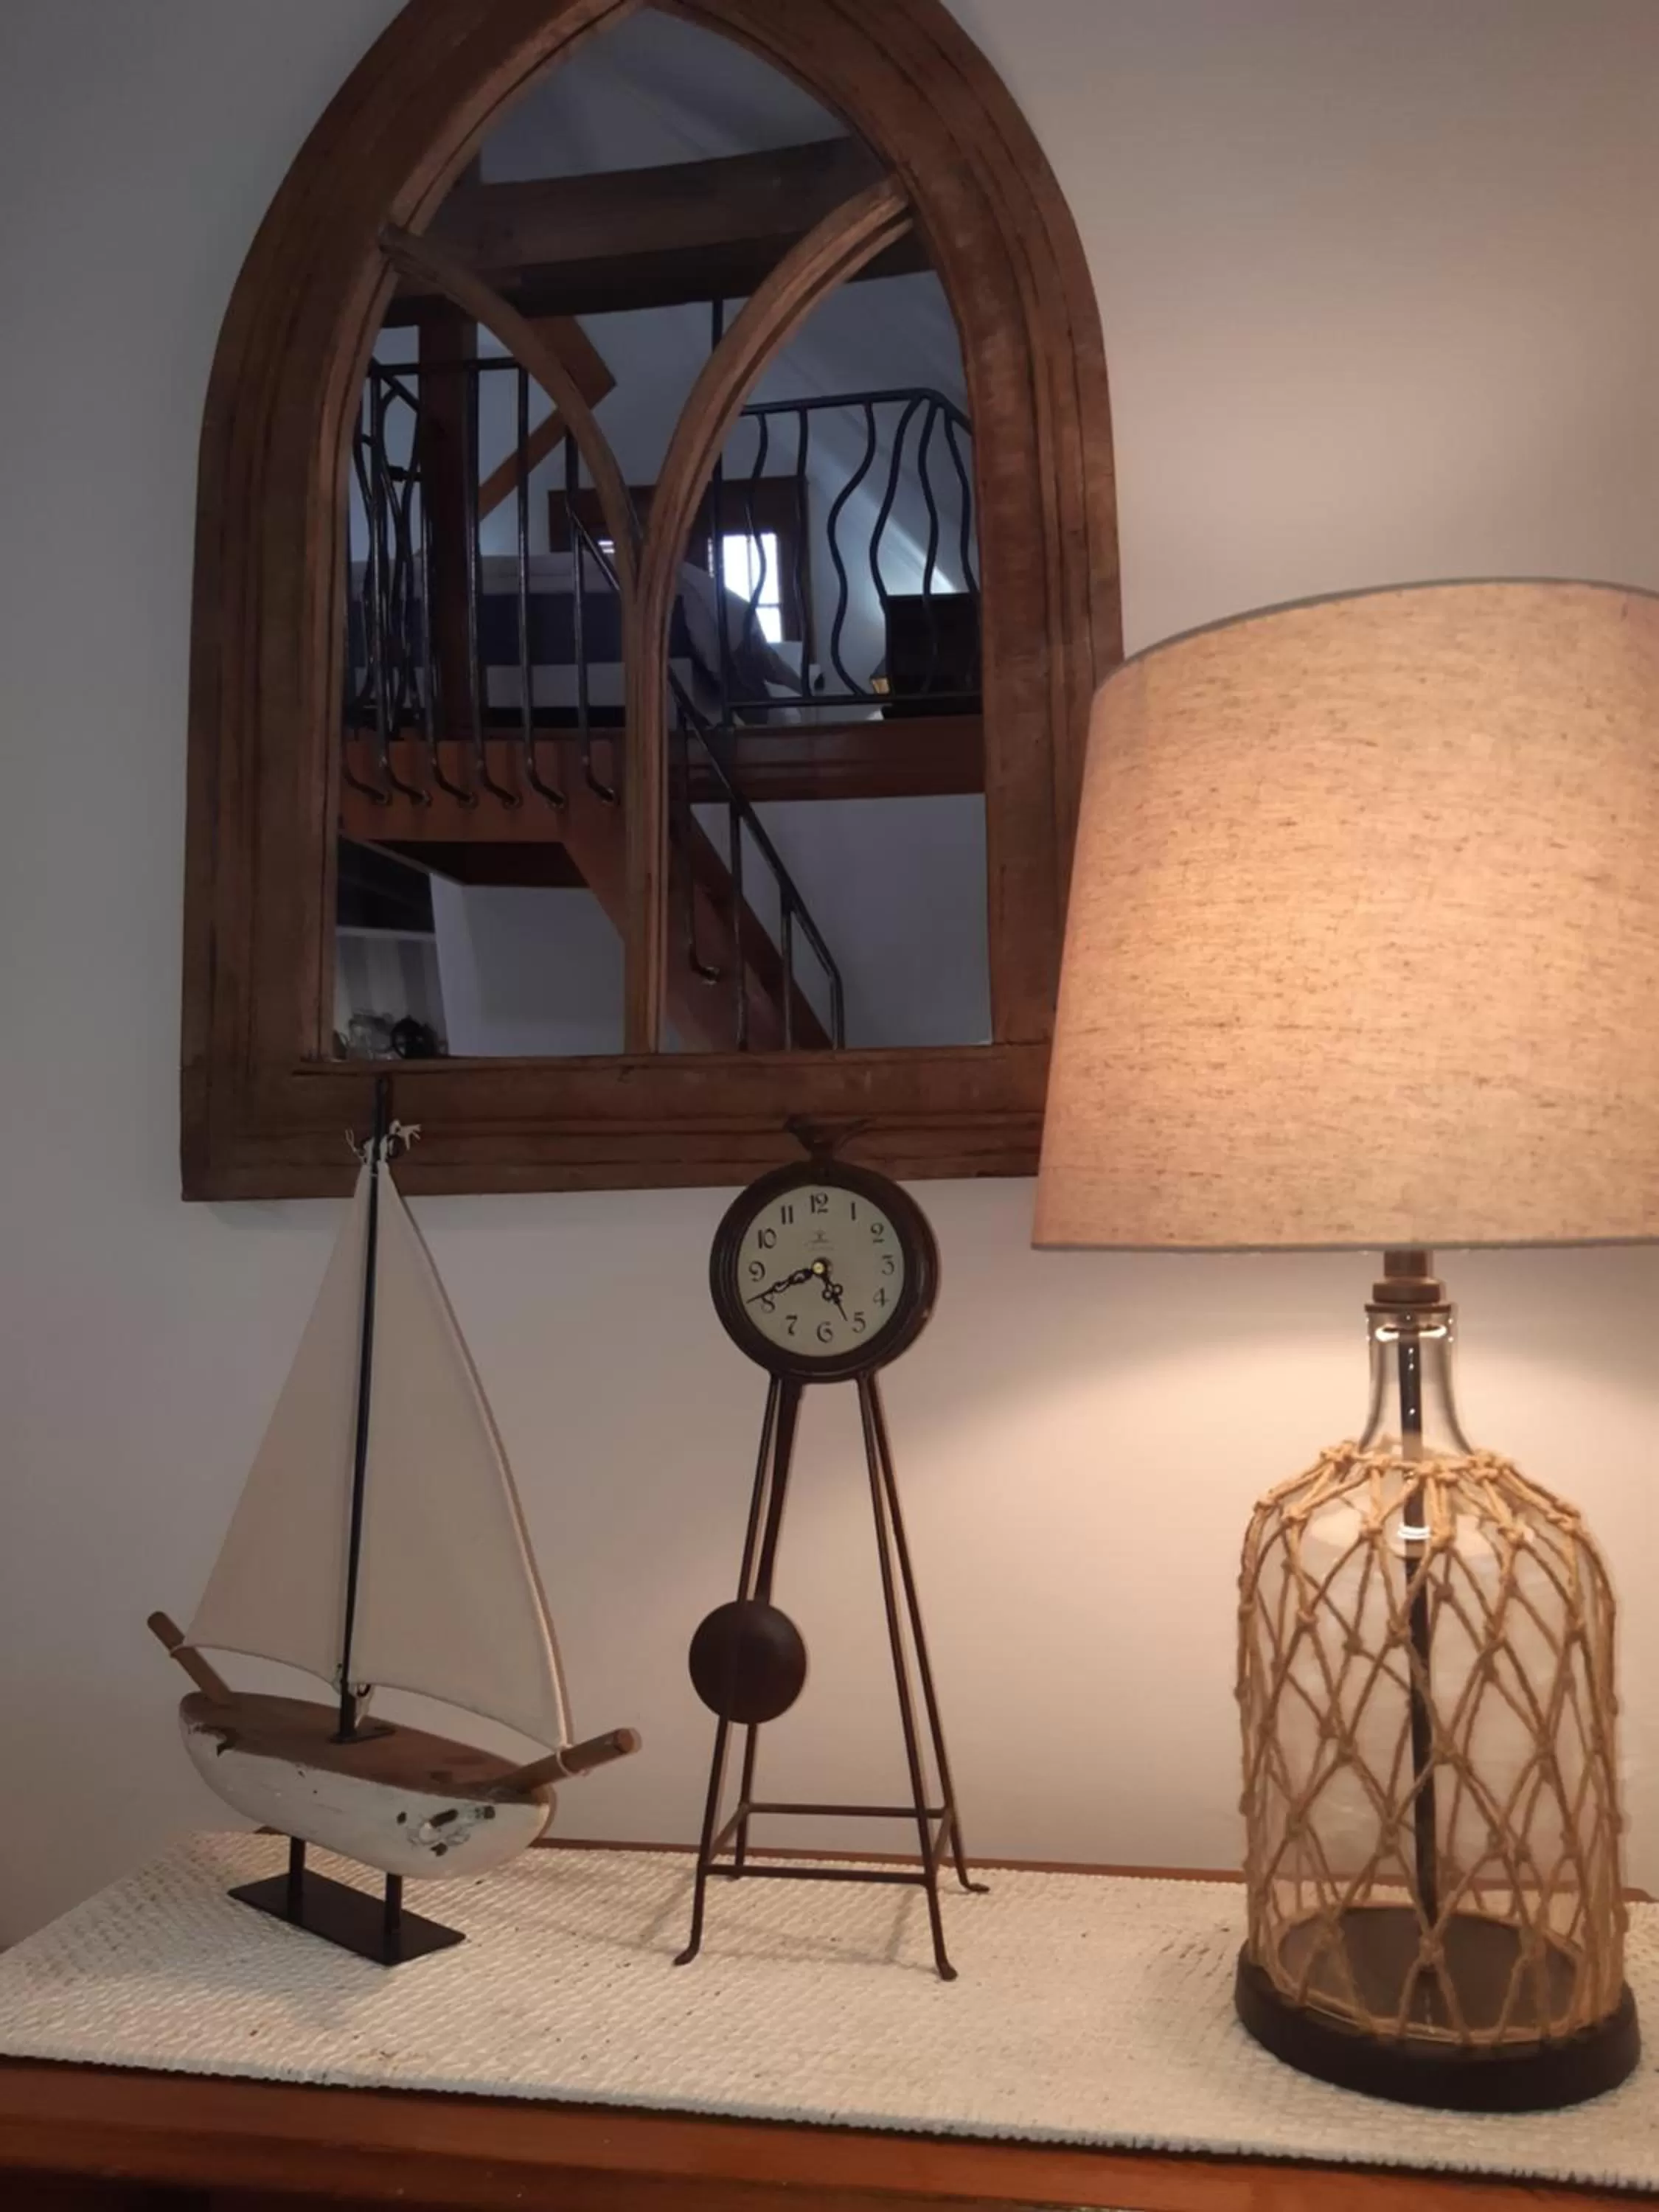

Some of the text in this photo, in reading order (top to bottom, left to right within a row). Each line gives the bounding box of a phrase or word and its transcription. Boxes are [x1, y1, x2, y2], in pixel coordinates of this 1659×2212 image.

[810, 1192, 829, 1214] 12
[851, 1201, 856, 1221] 1
[781, 1205, 793, 1225] 11
[757, 1228, 777, 1249] 10
[870, 1222, 885, 1243] 2
[748, 1261, 765, 1282] 9
[882, 1255, 894, 1276] 3
[760, 1293, 776, 1313] 8
[873, 1287, 888, 1308] 4
[785, 1315, 798, 1336] 7
[816, 1321, 833, 1343] 6
[852, 1312, 866, 1333] 5
